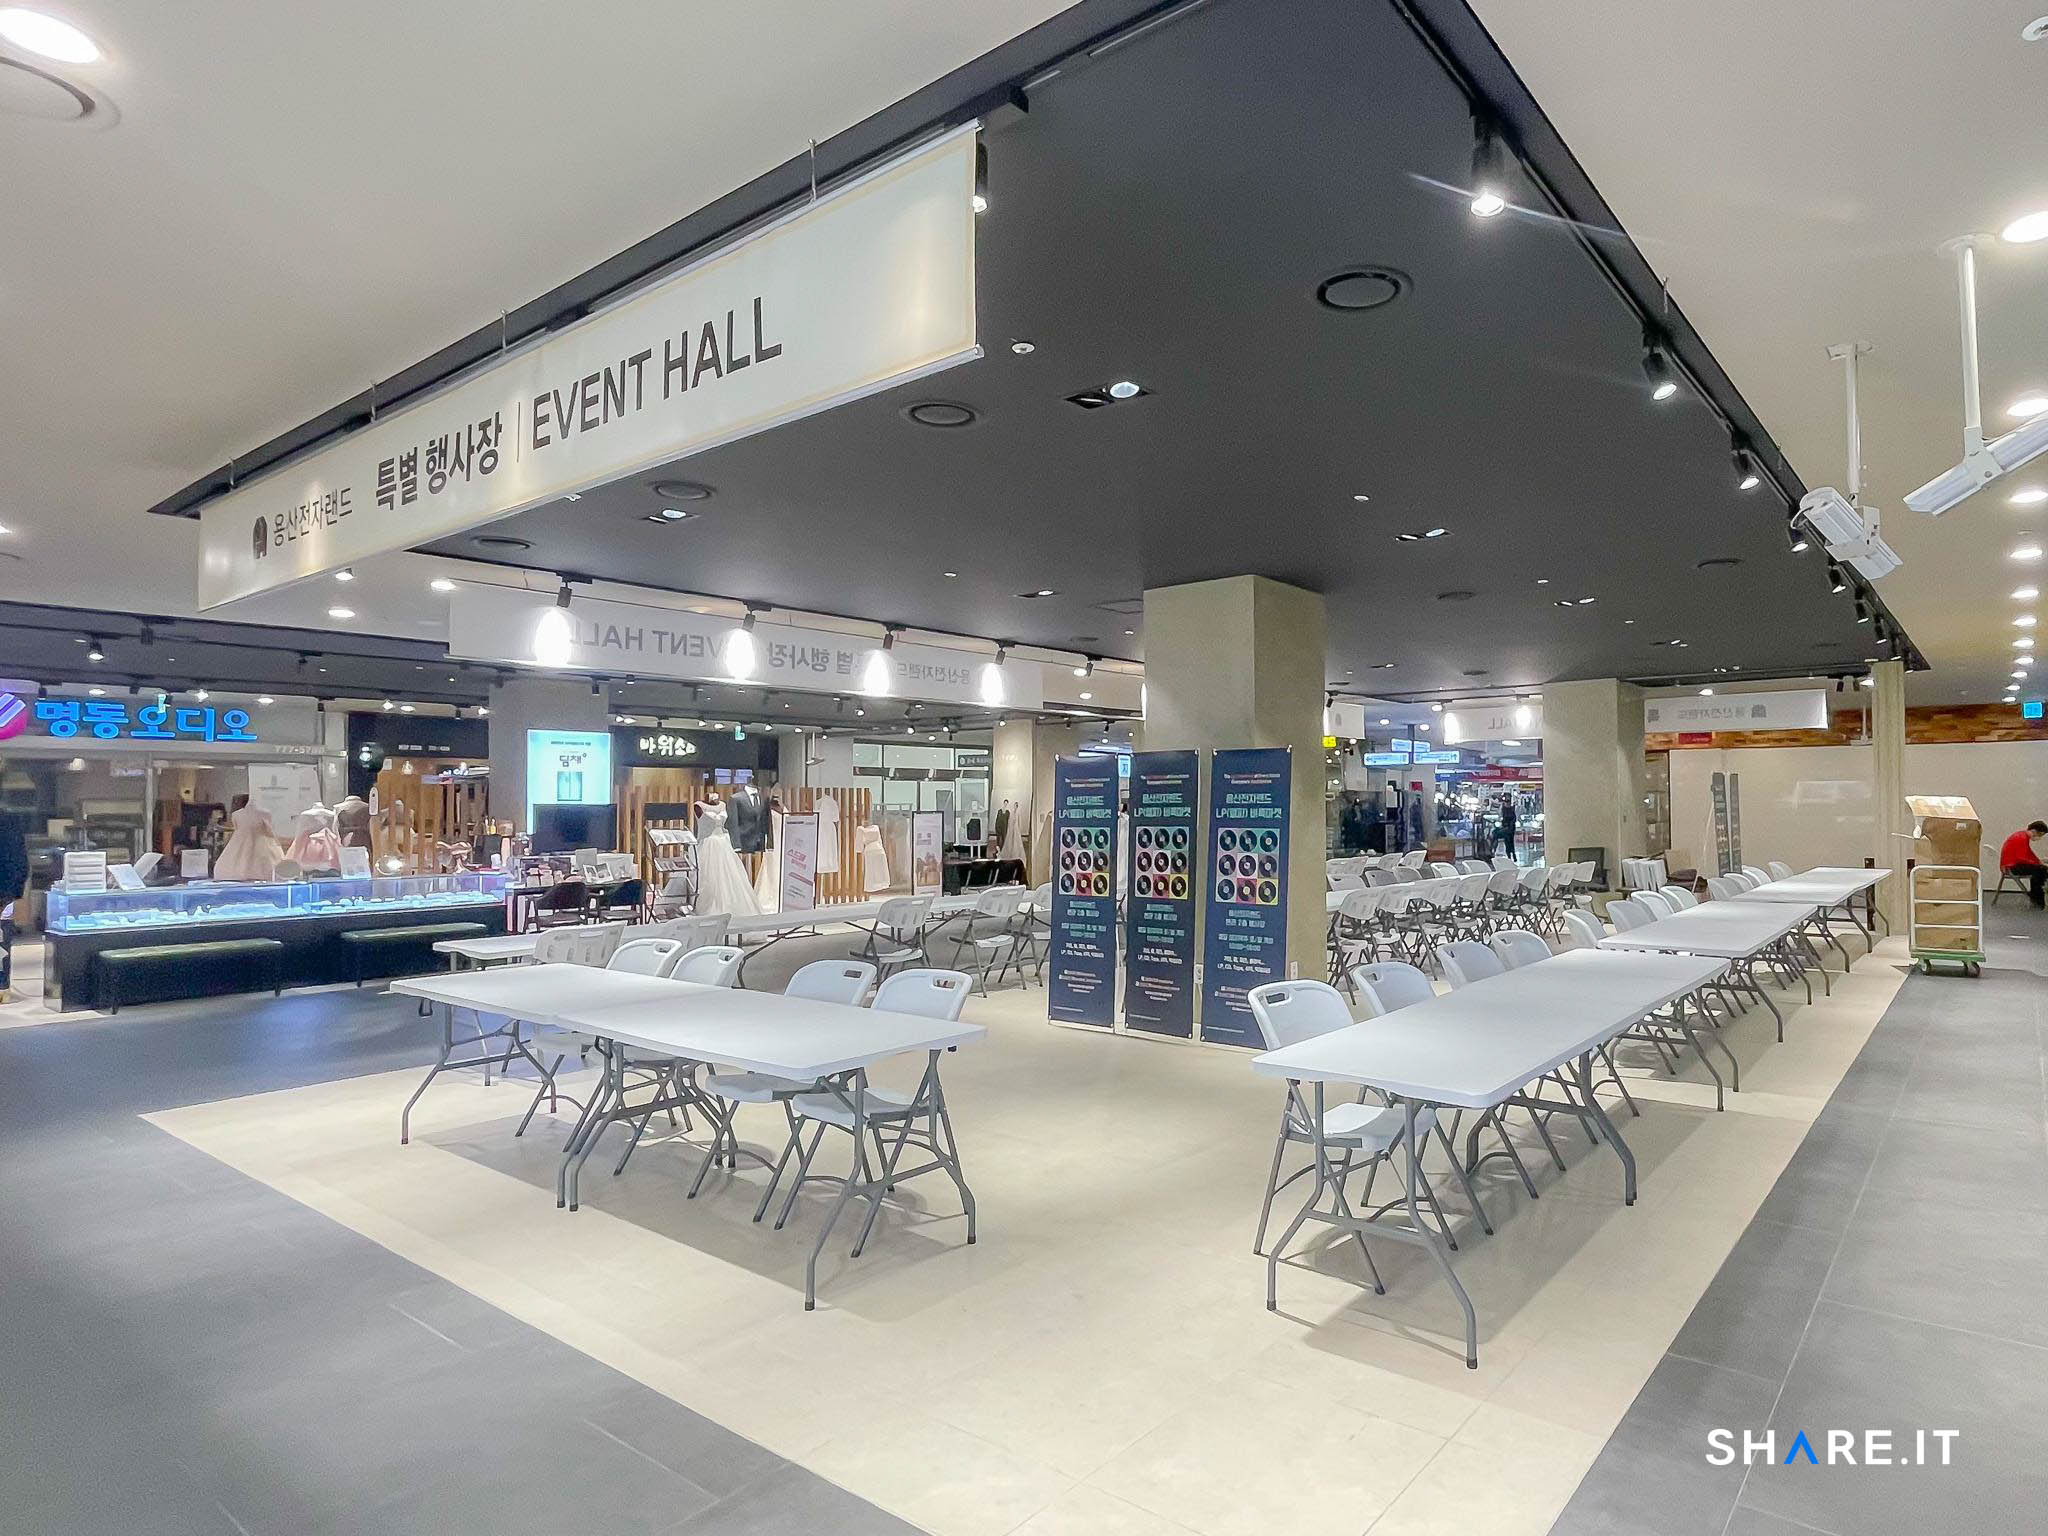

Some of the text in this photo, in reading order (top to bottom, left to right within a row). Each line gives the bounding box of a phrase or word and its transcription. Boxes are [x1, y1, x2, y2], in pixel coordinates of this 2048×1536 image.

[273, 296, 782, 547] 용산전자랜드 특별 행사장 EVENT HALL
